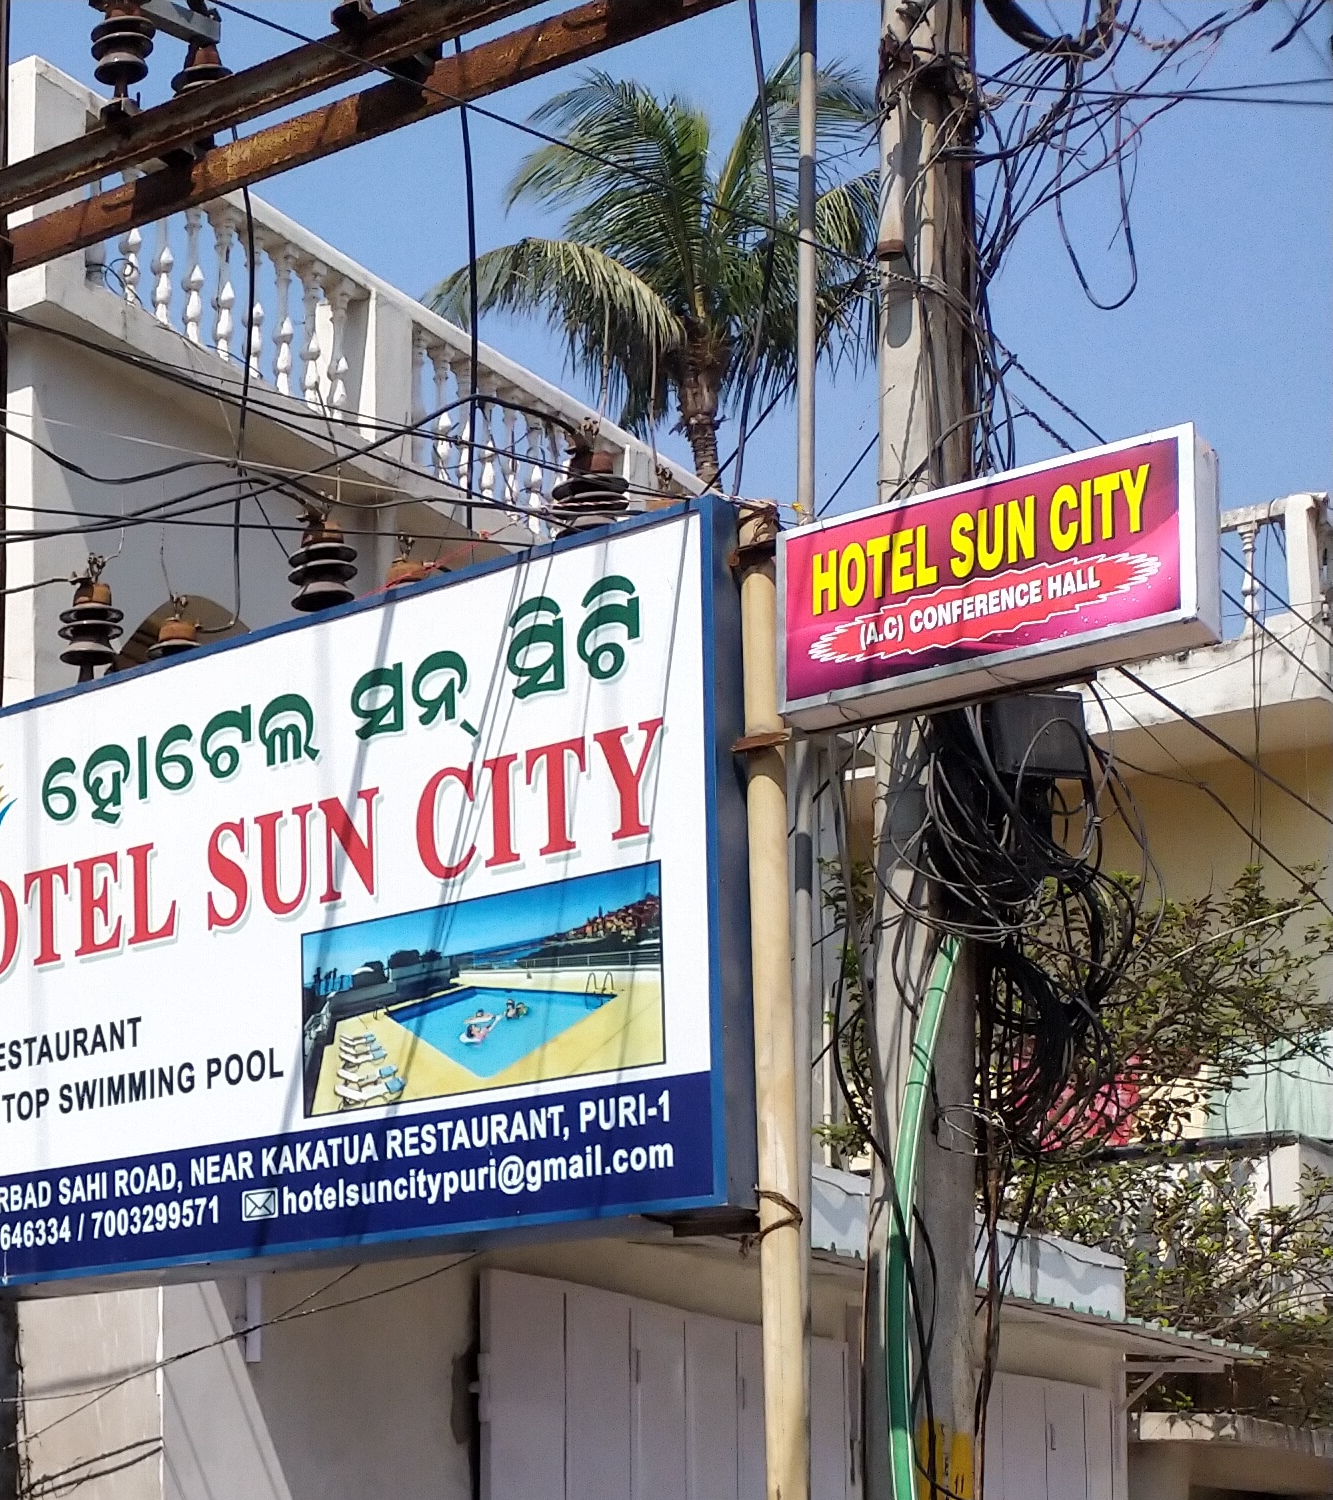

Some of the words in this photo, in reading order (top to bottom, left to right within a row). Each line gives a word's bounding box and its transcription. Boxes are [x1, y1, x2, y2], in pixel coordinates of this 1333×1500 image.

[813, 525, 937, 615] HOTEL
[951, 496, 1035, 577] SUN
[1050, 465, 1149, 551] CITY
[860, 615, 903, 650] (A.C)
[909, 580, 1042, 633] CONFERENCE
[1048, 566, 1100, 599] HALL
[42, 694, 319, 827] ହୋଟେଲ
[351, 651, 481, 747] ସନ୍
[506, 576, 640, 705] ସିଟି
[208, 788, 378, 928] SUN
[417, 719, 661, 878] CITY
[2, 1088, 49, 1123] TOP
[59, 1062, 194, 1114] SWIMMING
[207, 1048, 283, 1089] POOL
[59, 1172, 106, 1204] SAHI
[115, 1163, 182, 1197] ROAD,
[191, 1151, 253, 1186] NEAR
[262, 1133, 378, 1176] KAKATUA
[387, 1105, 569, 1159] RESTAURANT,
[580, 1090, 669, 1132] PURI-1
[282, 1140, 674, 1214] hotelsuncitypuri@gmail.com
[78, 1214, 84, 1241] /
[92, 1196, 218, 1238] 7003299571
